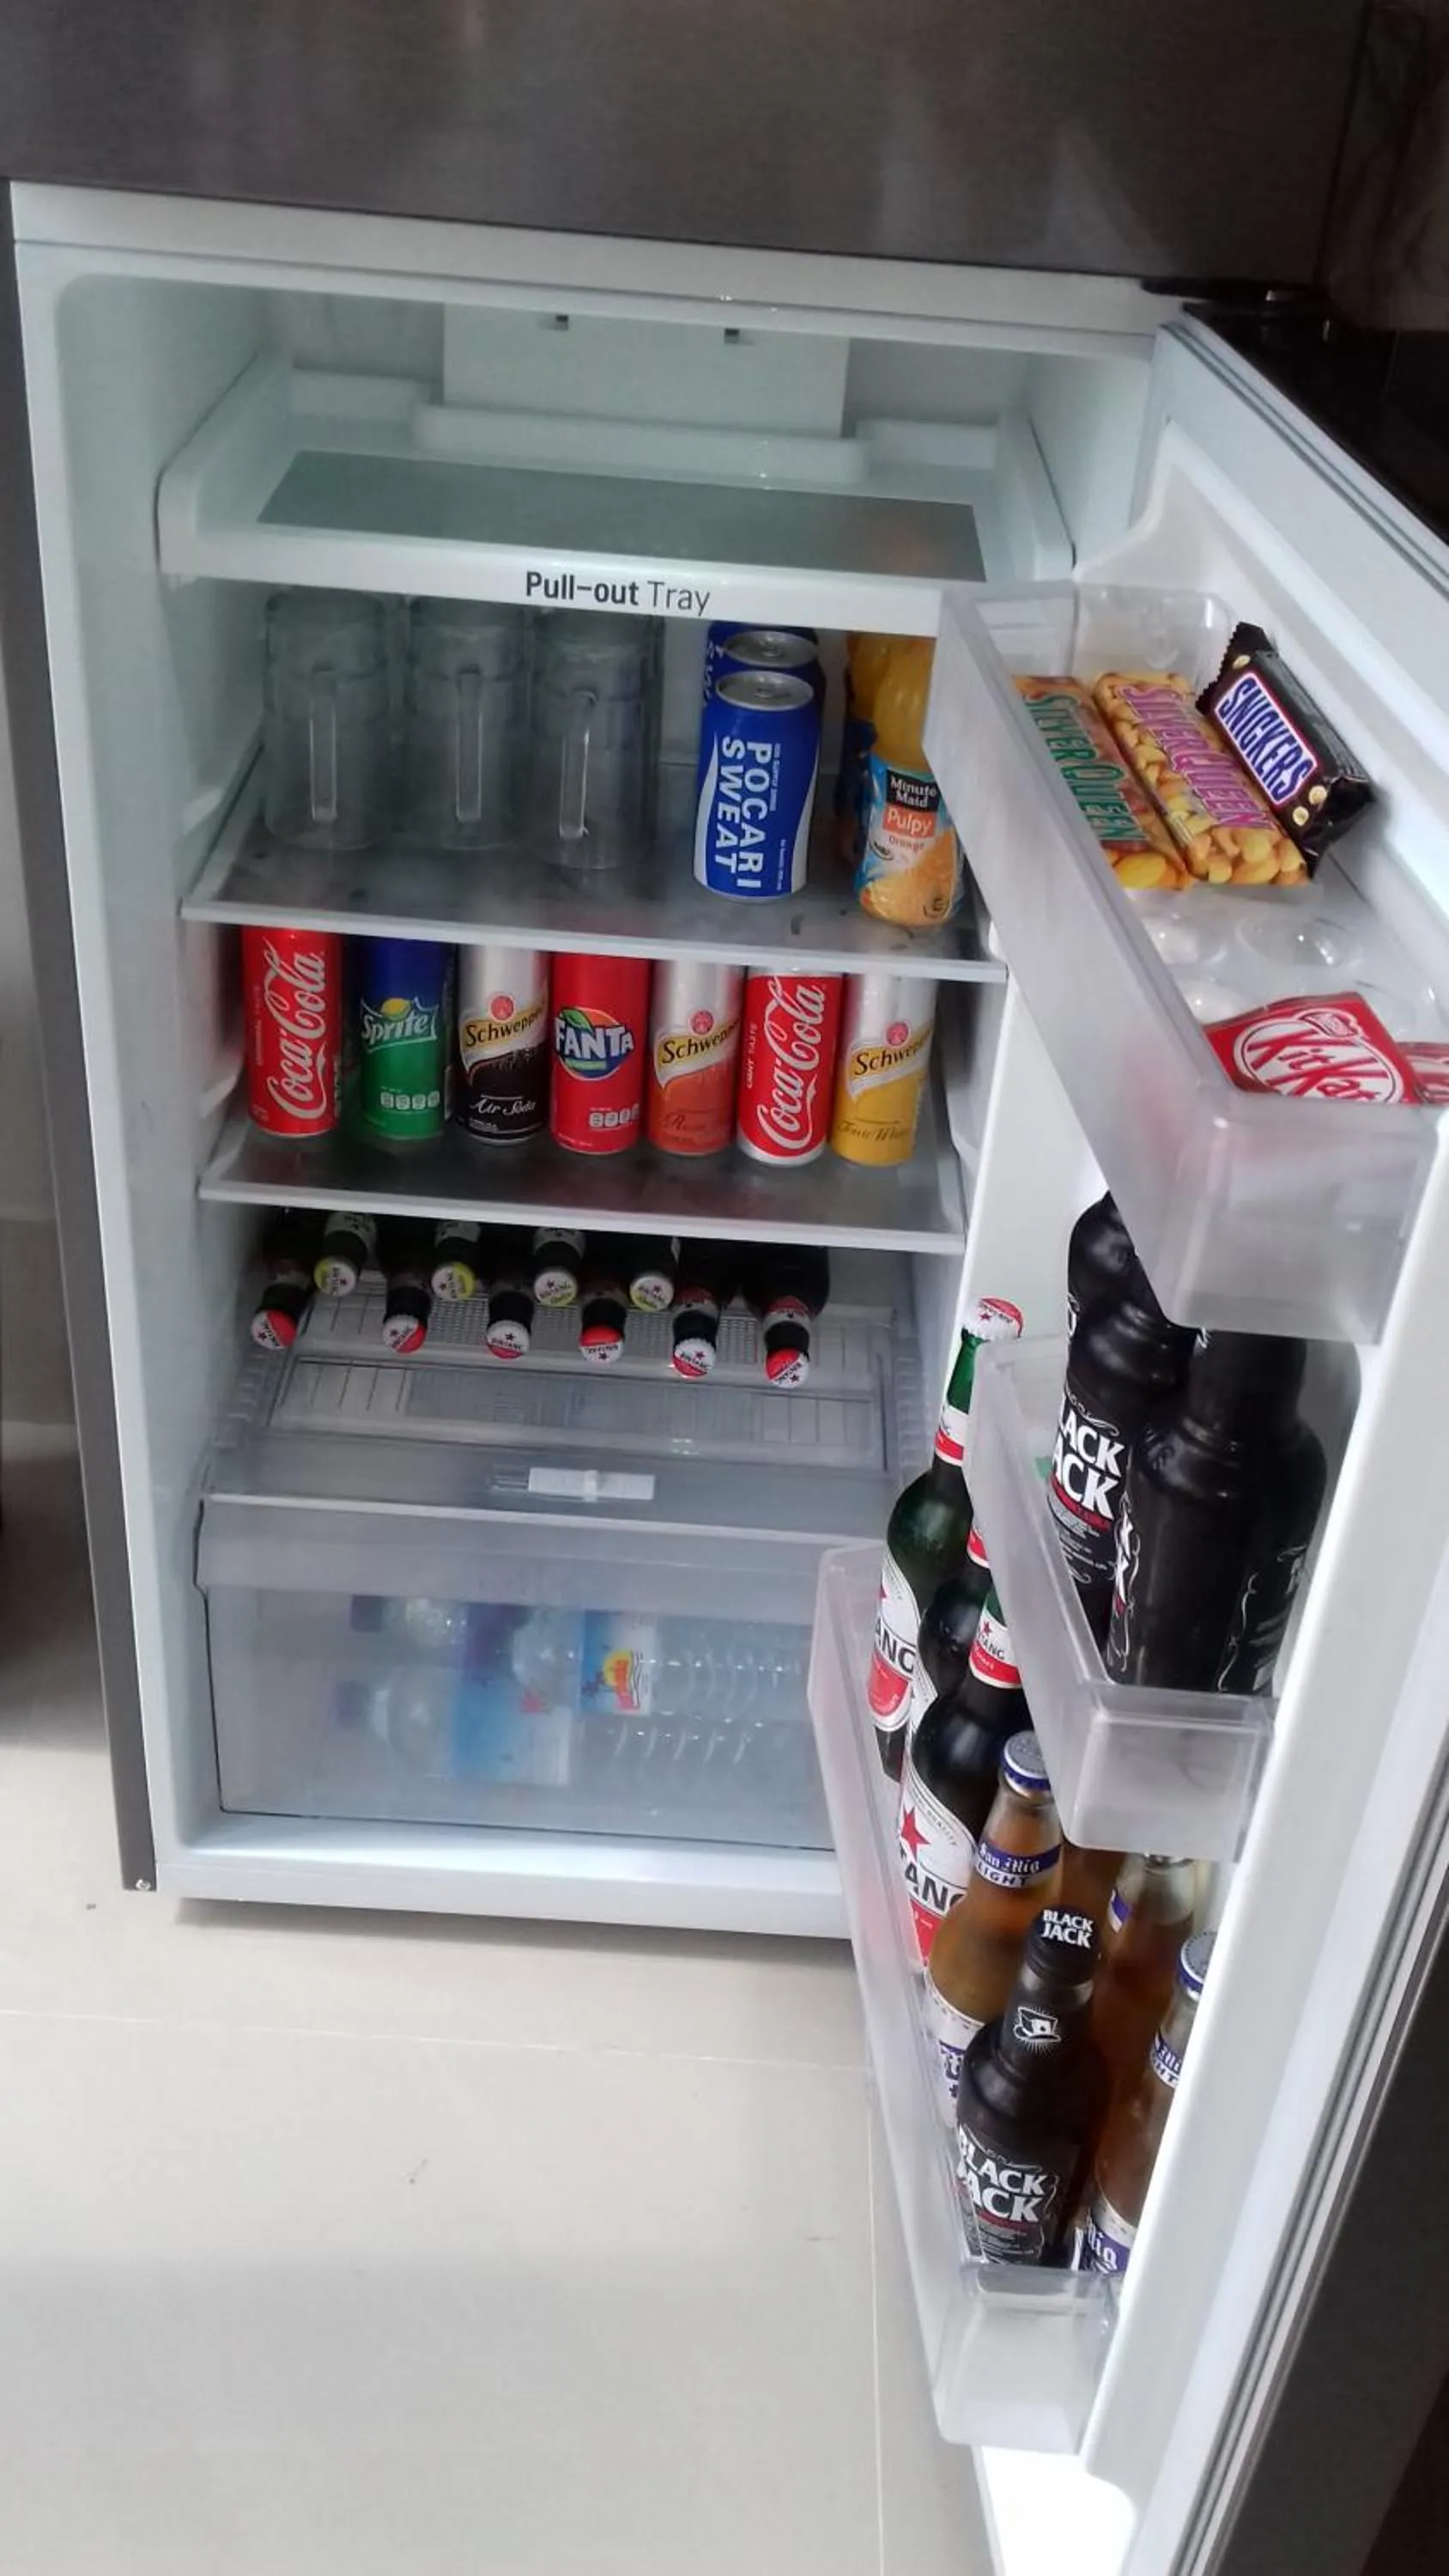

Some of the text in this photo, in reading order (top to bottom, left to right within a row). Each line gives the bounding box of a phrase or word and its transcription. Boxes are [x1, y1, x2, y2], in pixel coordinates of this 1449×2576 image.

[526, 571, 711, 617] Pull-out Tray
[1218, 677, 1314, 801] SNICKERS
[714, 736, 746, 874] SWEAT
[890, 775, 937, 796] Minute
[895, 790, 929, 808] Maid
[737, 741, 773, 889] POCARI
[888, 808, 933, 836] Pulpy
[263, 936, 327, 1120] Coca-Cola
[361, 1010, 429, 1046] Sprite
[555, 1017, 634, 1060] FANTA
[757, 975, 826, 1150] Coca-Cola
[1059, 1393, 1125, 1478] LACK
[1052, 1431, 1119, 1521] ACK
[978, 1861, 1028, 1886] LIGHT
[1041, 1923, 1092, 1948] JACK
[1043, 1909, 1094, 1933] BLACK
